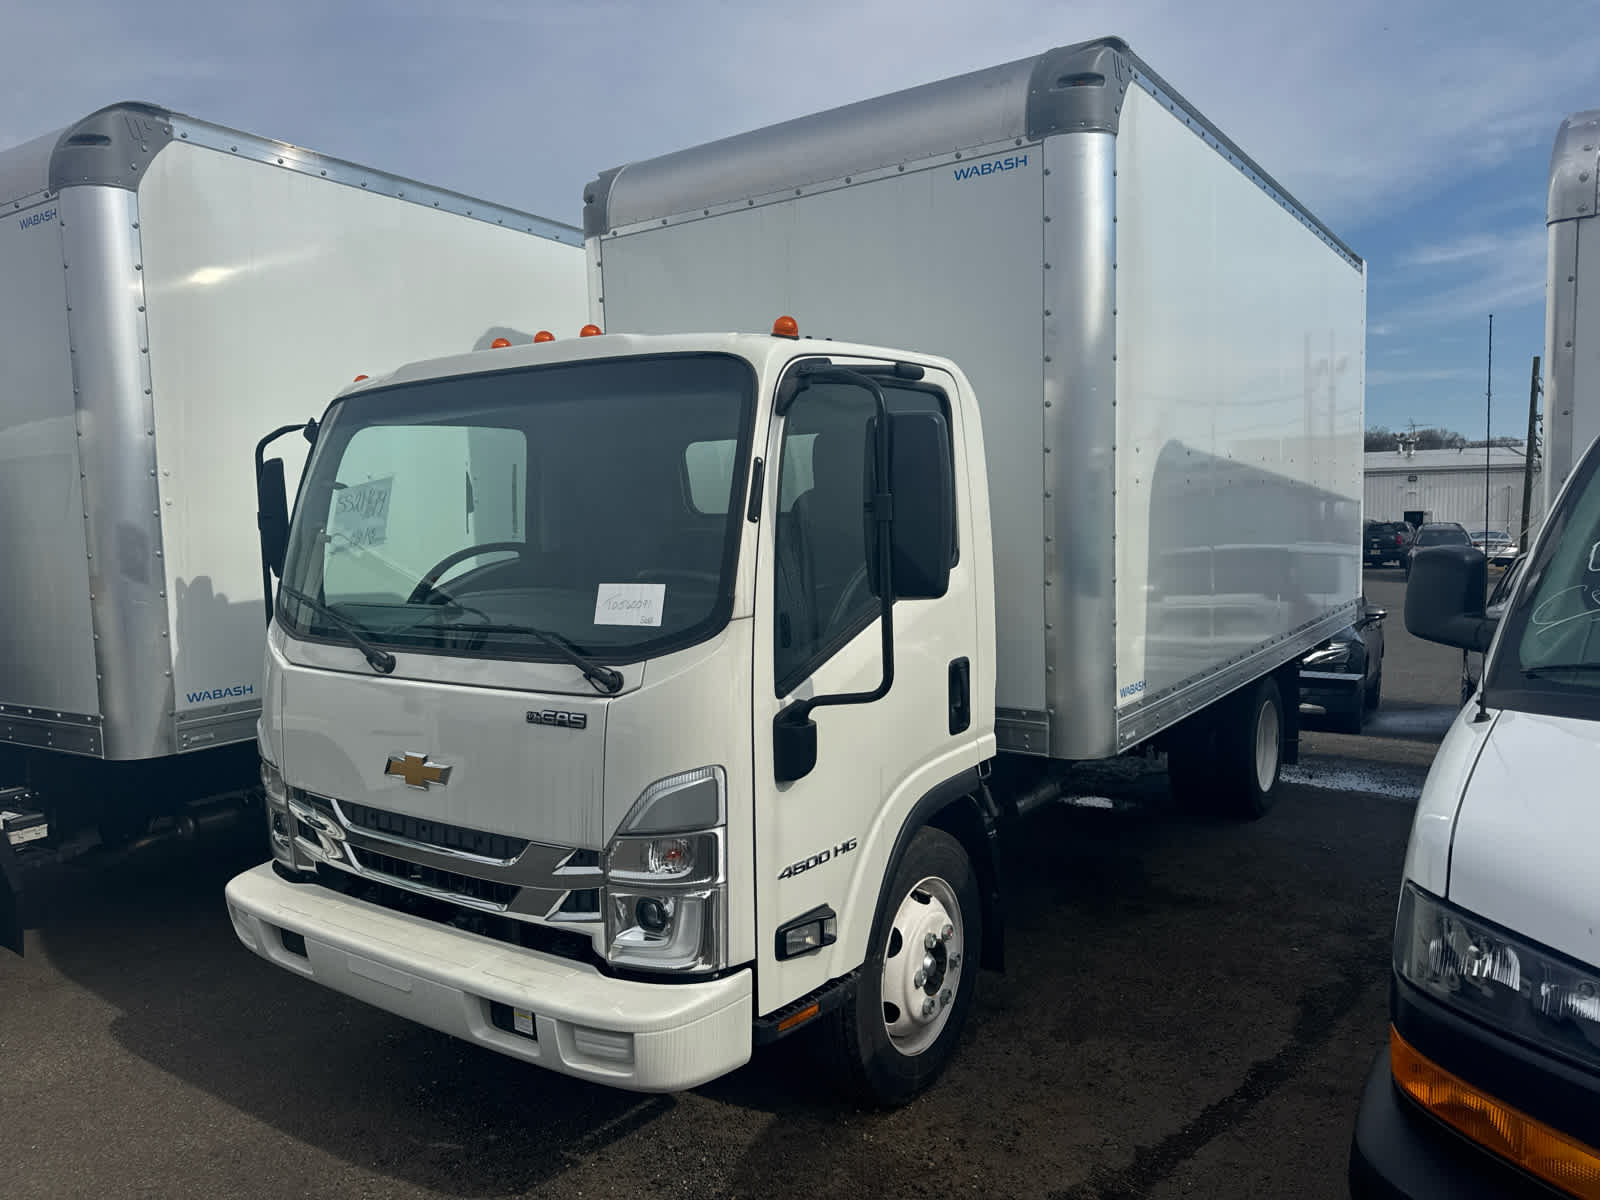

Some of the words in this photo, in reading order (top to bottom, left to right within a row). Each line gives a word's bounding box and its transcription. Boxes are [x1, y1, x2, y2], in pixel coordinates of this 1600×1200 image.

[954, 155, 1028, 181] WABASH
[19, 208, 57, 230] WABASH
[186, 684, 254, 703] WABASH
[1120, 680, 1147, 698] WABASH
[541, 710, 586, 729] GAS
[777, 849, 831, 880] 4500
[833, 837, 857, 858] HG
